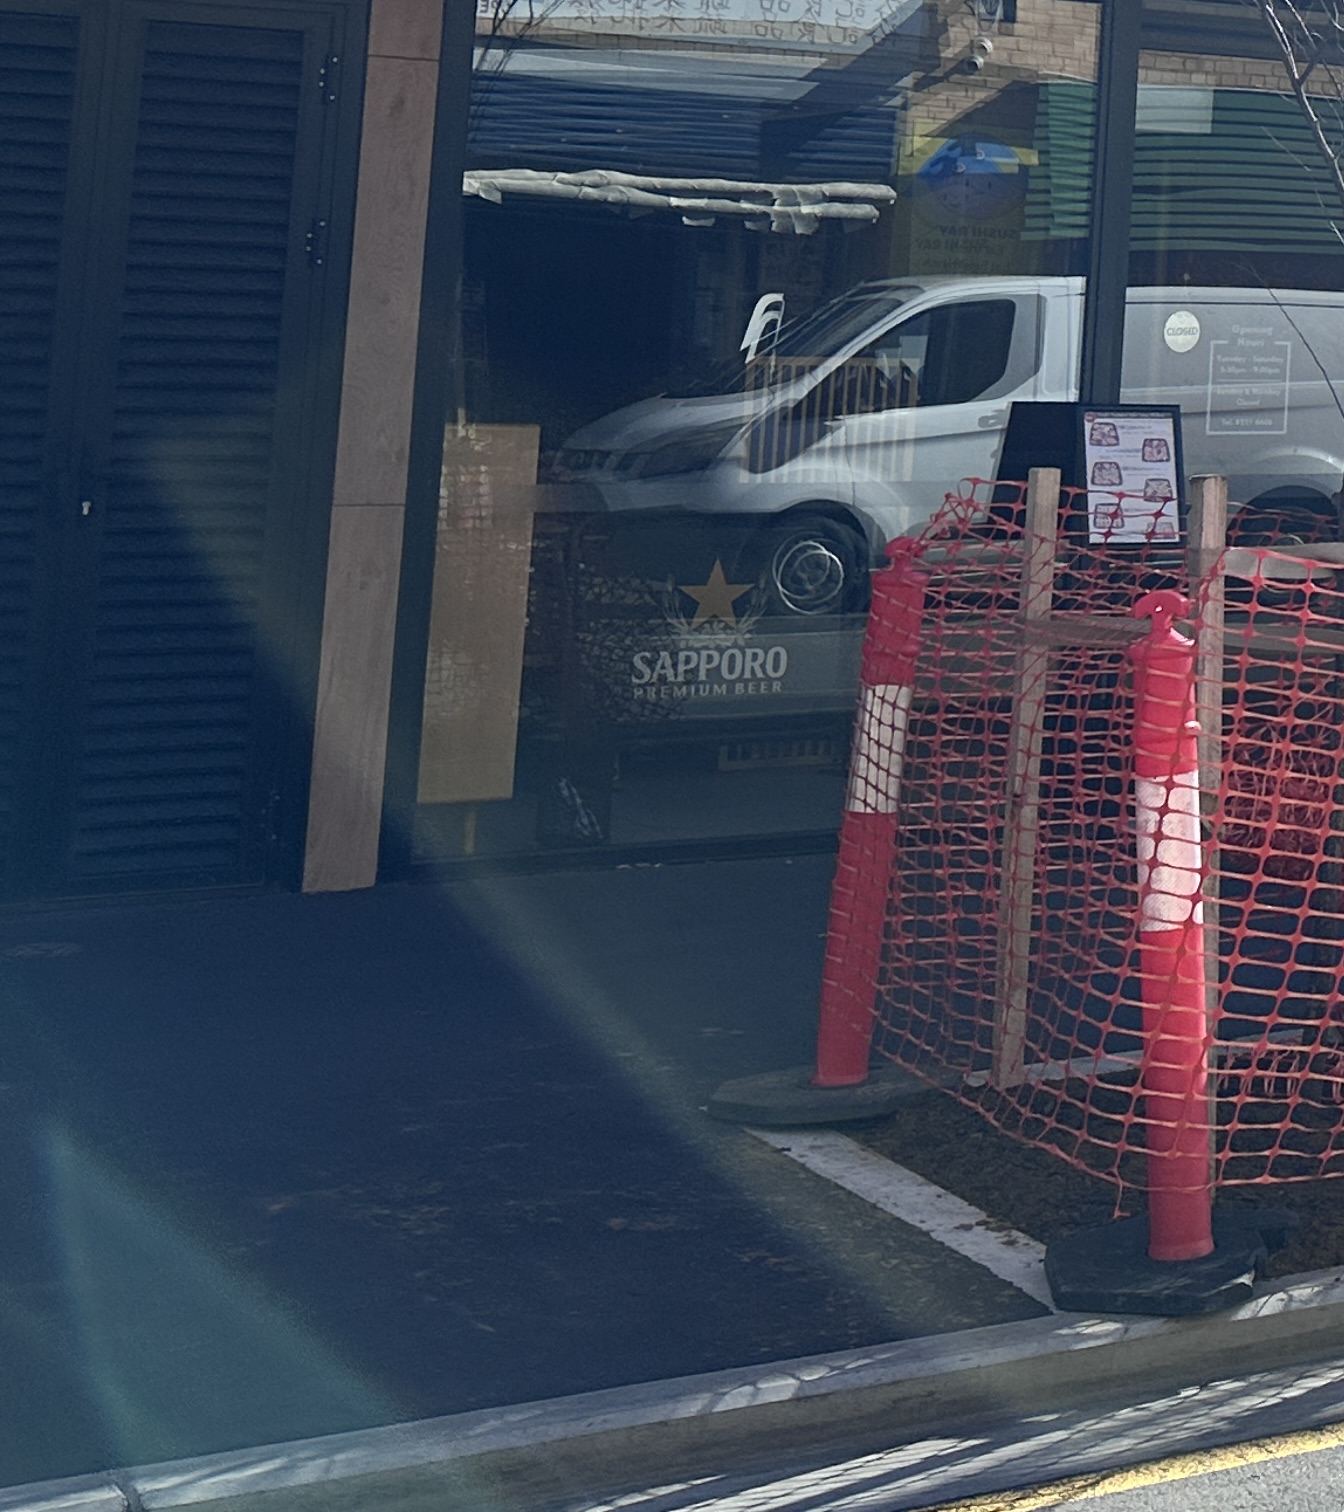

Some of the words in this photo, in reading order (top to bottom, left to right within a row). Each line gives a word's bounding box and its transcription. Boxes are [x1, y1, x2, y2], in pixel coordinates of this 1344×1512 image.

[1167, 327, 1198, 336] CLOSED
[1232, 324, 1273, 336] Opening
[1237, 337, 1265, 347] Hours
[631, 646, 788, 684] SAPPORO
[633, 684, 727, 700] PREMIUM
[735, 680, 782, 696] BEER
